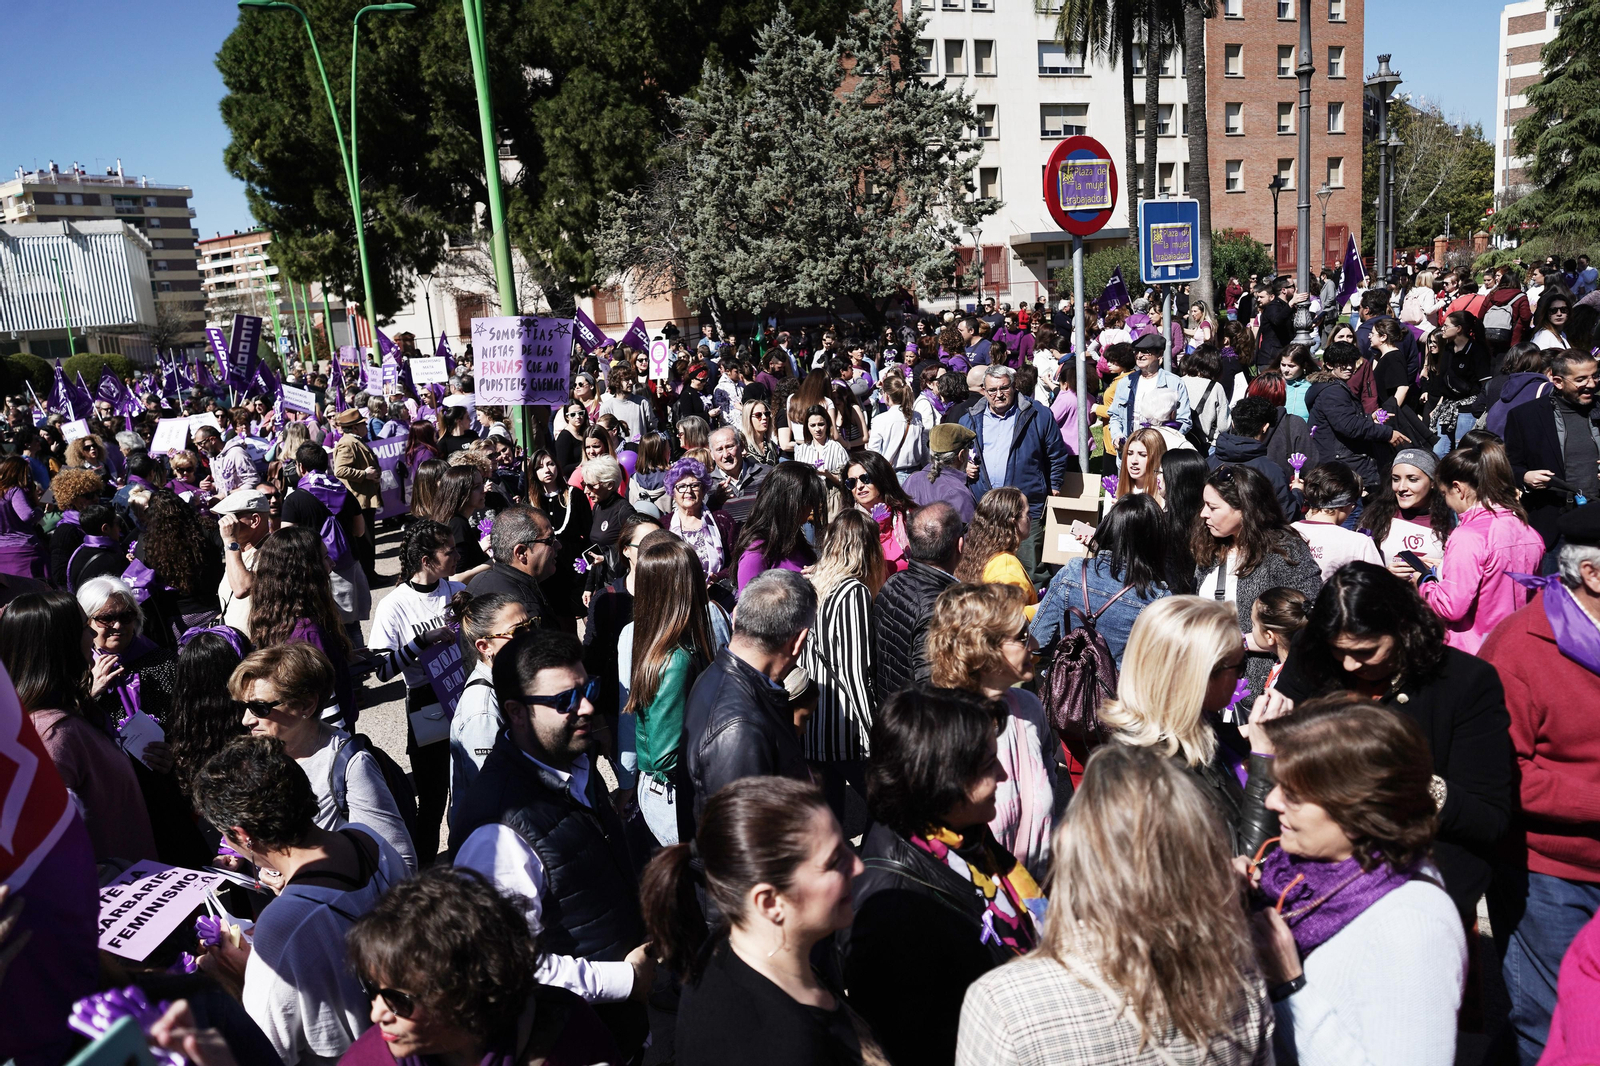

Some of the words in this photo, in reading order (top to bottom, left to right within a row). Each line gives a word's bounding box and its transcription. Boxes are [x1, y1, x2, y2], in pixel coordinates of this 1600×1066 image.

[1074, 166, 1093, 176] Plaza
[1097, 166, 1106, 176] de
[1075, 181, 1082, 190] la
[1085, 181, 1106, 192] mujer
[1066, 194, 1108, 206] trabajadora
[1163, 230, 1179, 238] Plaza
[1181, 229, 1189, 237] de
[1163, 241, 1169, 249] la
[1171, 239, 1189, 250] mujer
[1156, 251, 1190, 262] trabajadora
[237, 317, 255, 365] CCOO
[489, 327, 523, 341] SOMOS
[534, 328, 554, 341] LAS
[482, 344, 514, 359] NIETAS
[522, 344, 532, 356] DE
[537, 344, 553, 357] LAS
[482, 360, 523, 377] BRUJAS
[546, 361, 559, 373] NO
[480, 377, 527, 392] PUDISTEIS
[372, 440, 408, 459] MUJE
[430, 645, 460, 676] SOY
[119, 871, 148, 886] LA
[107, 873, 199, 949] FEMINISMO
